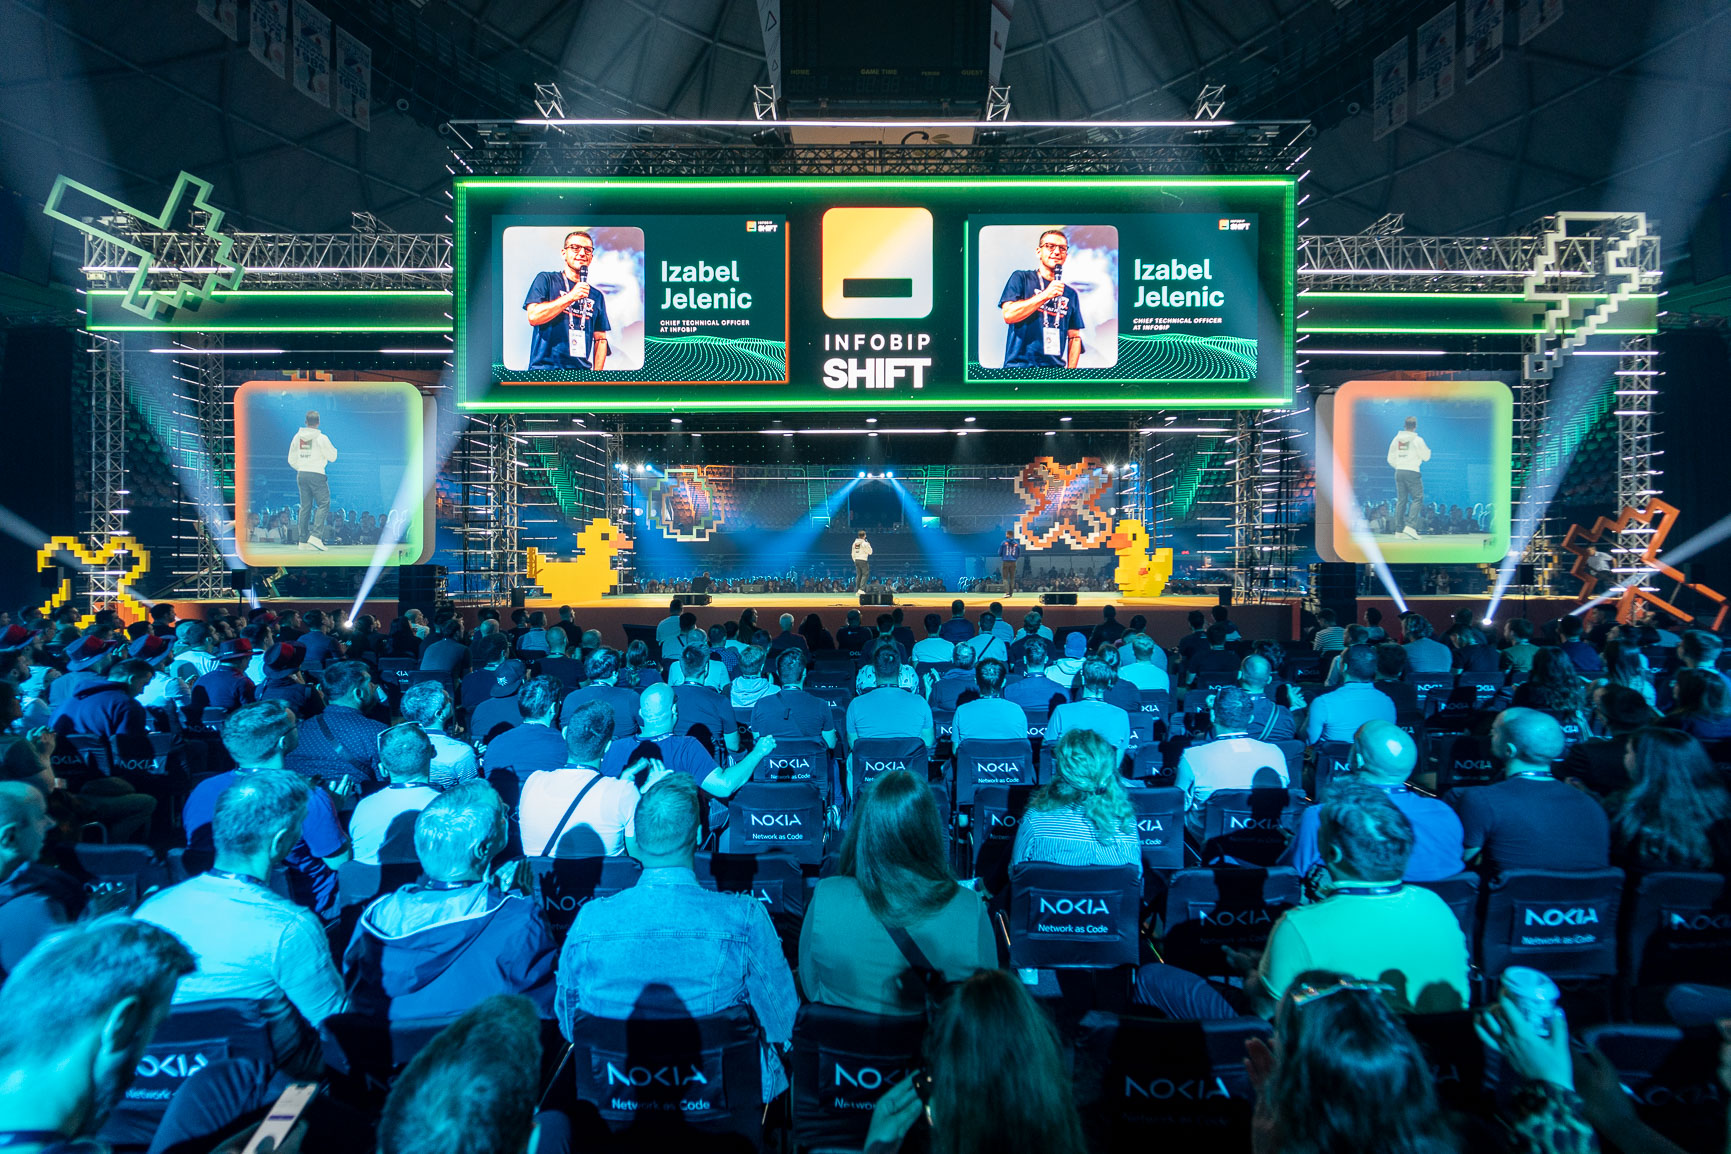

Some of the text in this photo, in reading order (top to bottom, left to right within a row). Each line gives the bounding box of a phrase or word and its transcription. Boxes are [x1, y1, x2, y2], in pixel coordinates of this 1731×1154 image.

[860, 68, 898, 76] GAME TIME
[960, 69, 984, 77] GUEST
[661, 260, 740, 283] Izabel
[1134, 258, 1213, 281] Izabel
[660, 287, 753, 310] Jelenic
[1133, 286, 1225, 308] Jelenic
[823, 333, 932, 351] INFOBIP
[822, 357, 933, 390] SHIFT
[51, 755, 84, 766] OKIA
[769, 758, 810, 770] NOKIA
[865, 761, 906, 771] NOKIA
[978, 762, 1019, 773] NOKIA
[751, 813, 802, 826] NOKIA
[1137, 819, 1163, 832] KIA
[786, 832, 803, 840] Code
[1039, 897, 1110, 916] NOKIA
[1200, 909, 1272, 927] NOKIA
[1524, 907, 1599, 927] NOKIA
[1037, 923, 1109, 934] Network as Code
[135, 1052, 209, 1078] OKIA
[607, 1061, 708, 1087] NOKIA
[835, 1062, 909, 1090] NOK
[1125, 1074, 1231, 1100] NOKIA
[611, 1097, 660, 1111] Network
[679, 1097, 711, 1111] Code
